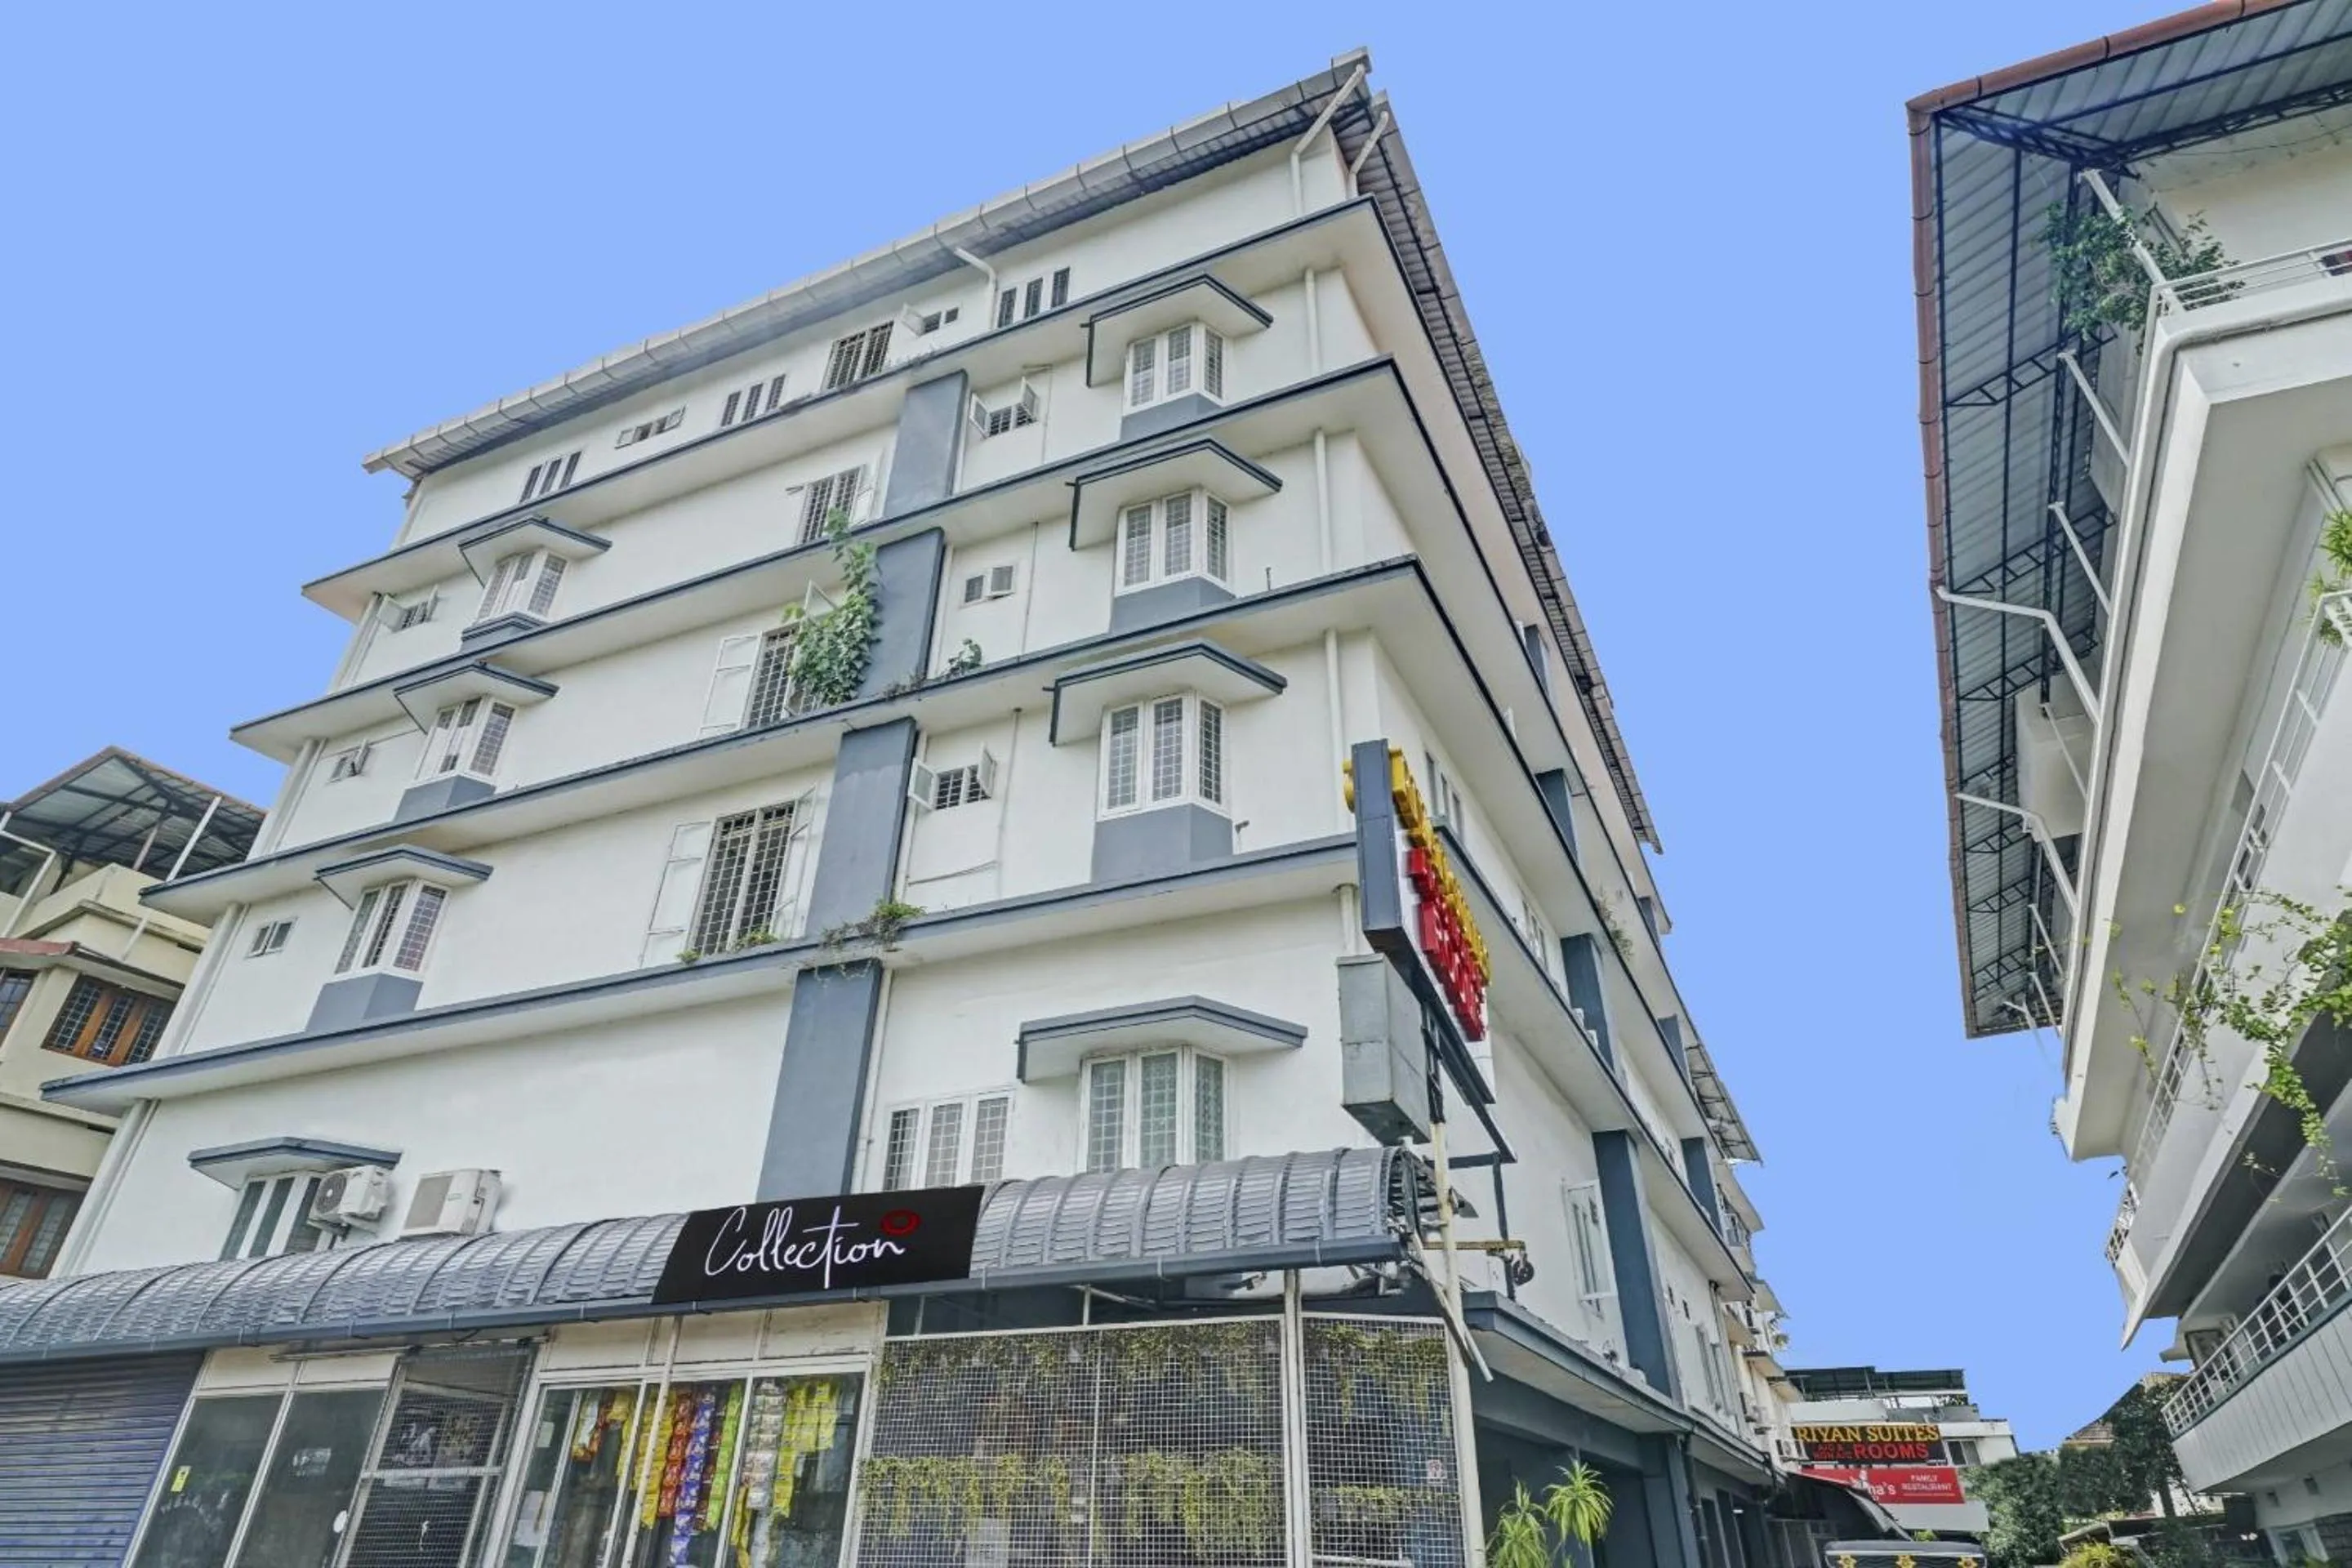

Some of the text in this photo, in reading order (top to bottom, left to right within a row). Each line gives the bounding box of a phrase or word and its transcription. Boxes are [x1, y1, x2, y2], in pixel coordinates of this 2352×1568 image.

[705, 1205, 905, 1290] Collection
[1797, 1425, 1939, 1442] RIYAN SUITES
[1854, 1443, 1929, 1459] ROOMS
